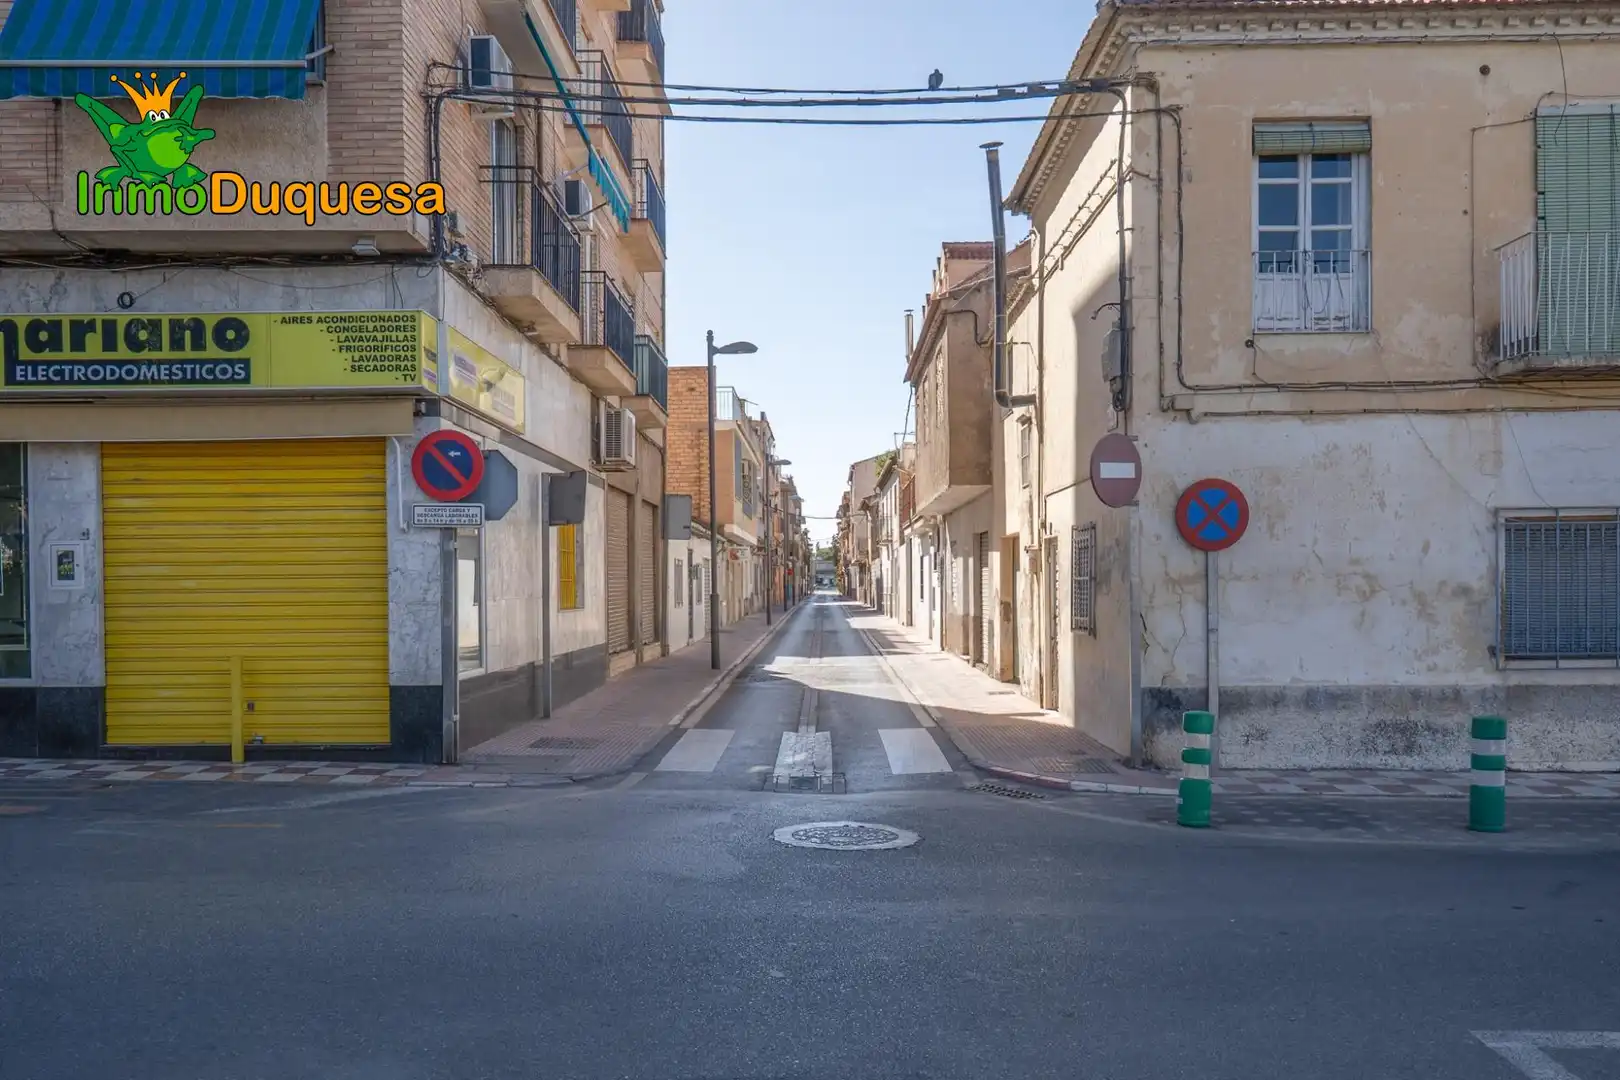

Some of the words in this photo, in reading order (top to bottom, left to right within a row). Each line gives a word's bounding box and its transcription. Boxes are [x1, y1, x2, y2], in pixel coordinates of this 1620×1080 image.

[280, 316, 313, 324] AIRES
[316, 315, 416, 324] ACONDICIONADOS
[326, 325, 416, 334] CONGELADORES
[336, 334, 416, 343] LAVAVAJILLAS
[351, 354, 416, 363] LAVADORAS
[15, 363, 246, 381] ELECTRODOMESTICOS
[350, 363, 416, 372] SECADORAS
[401, 373, 416, 382] TV
